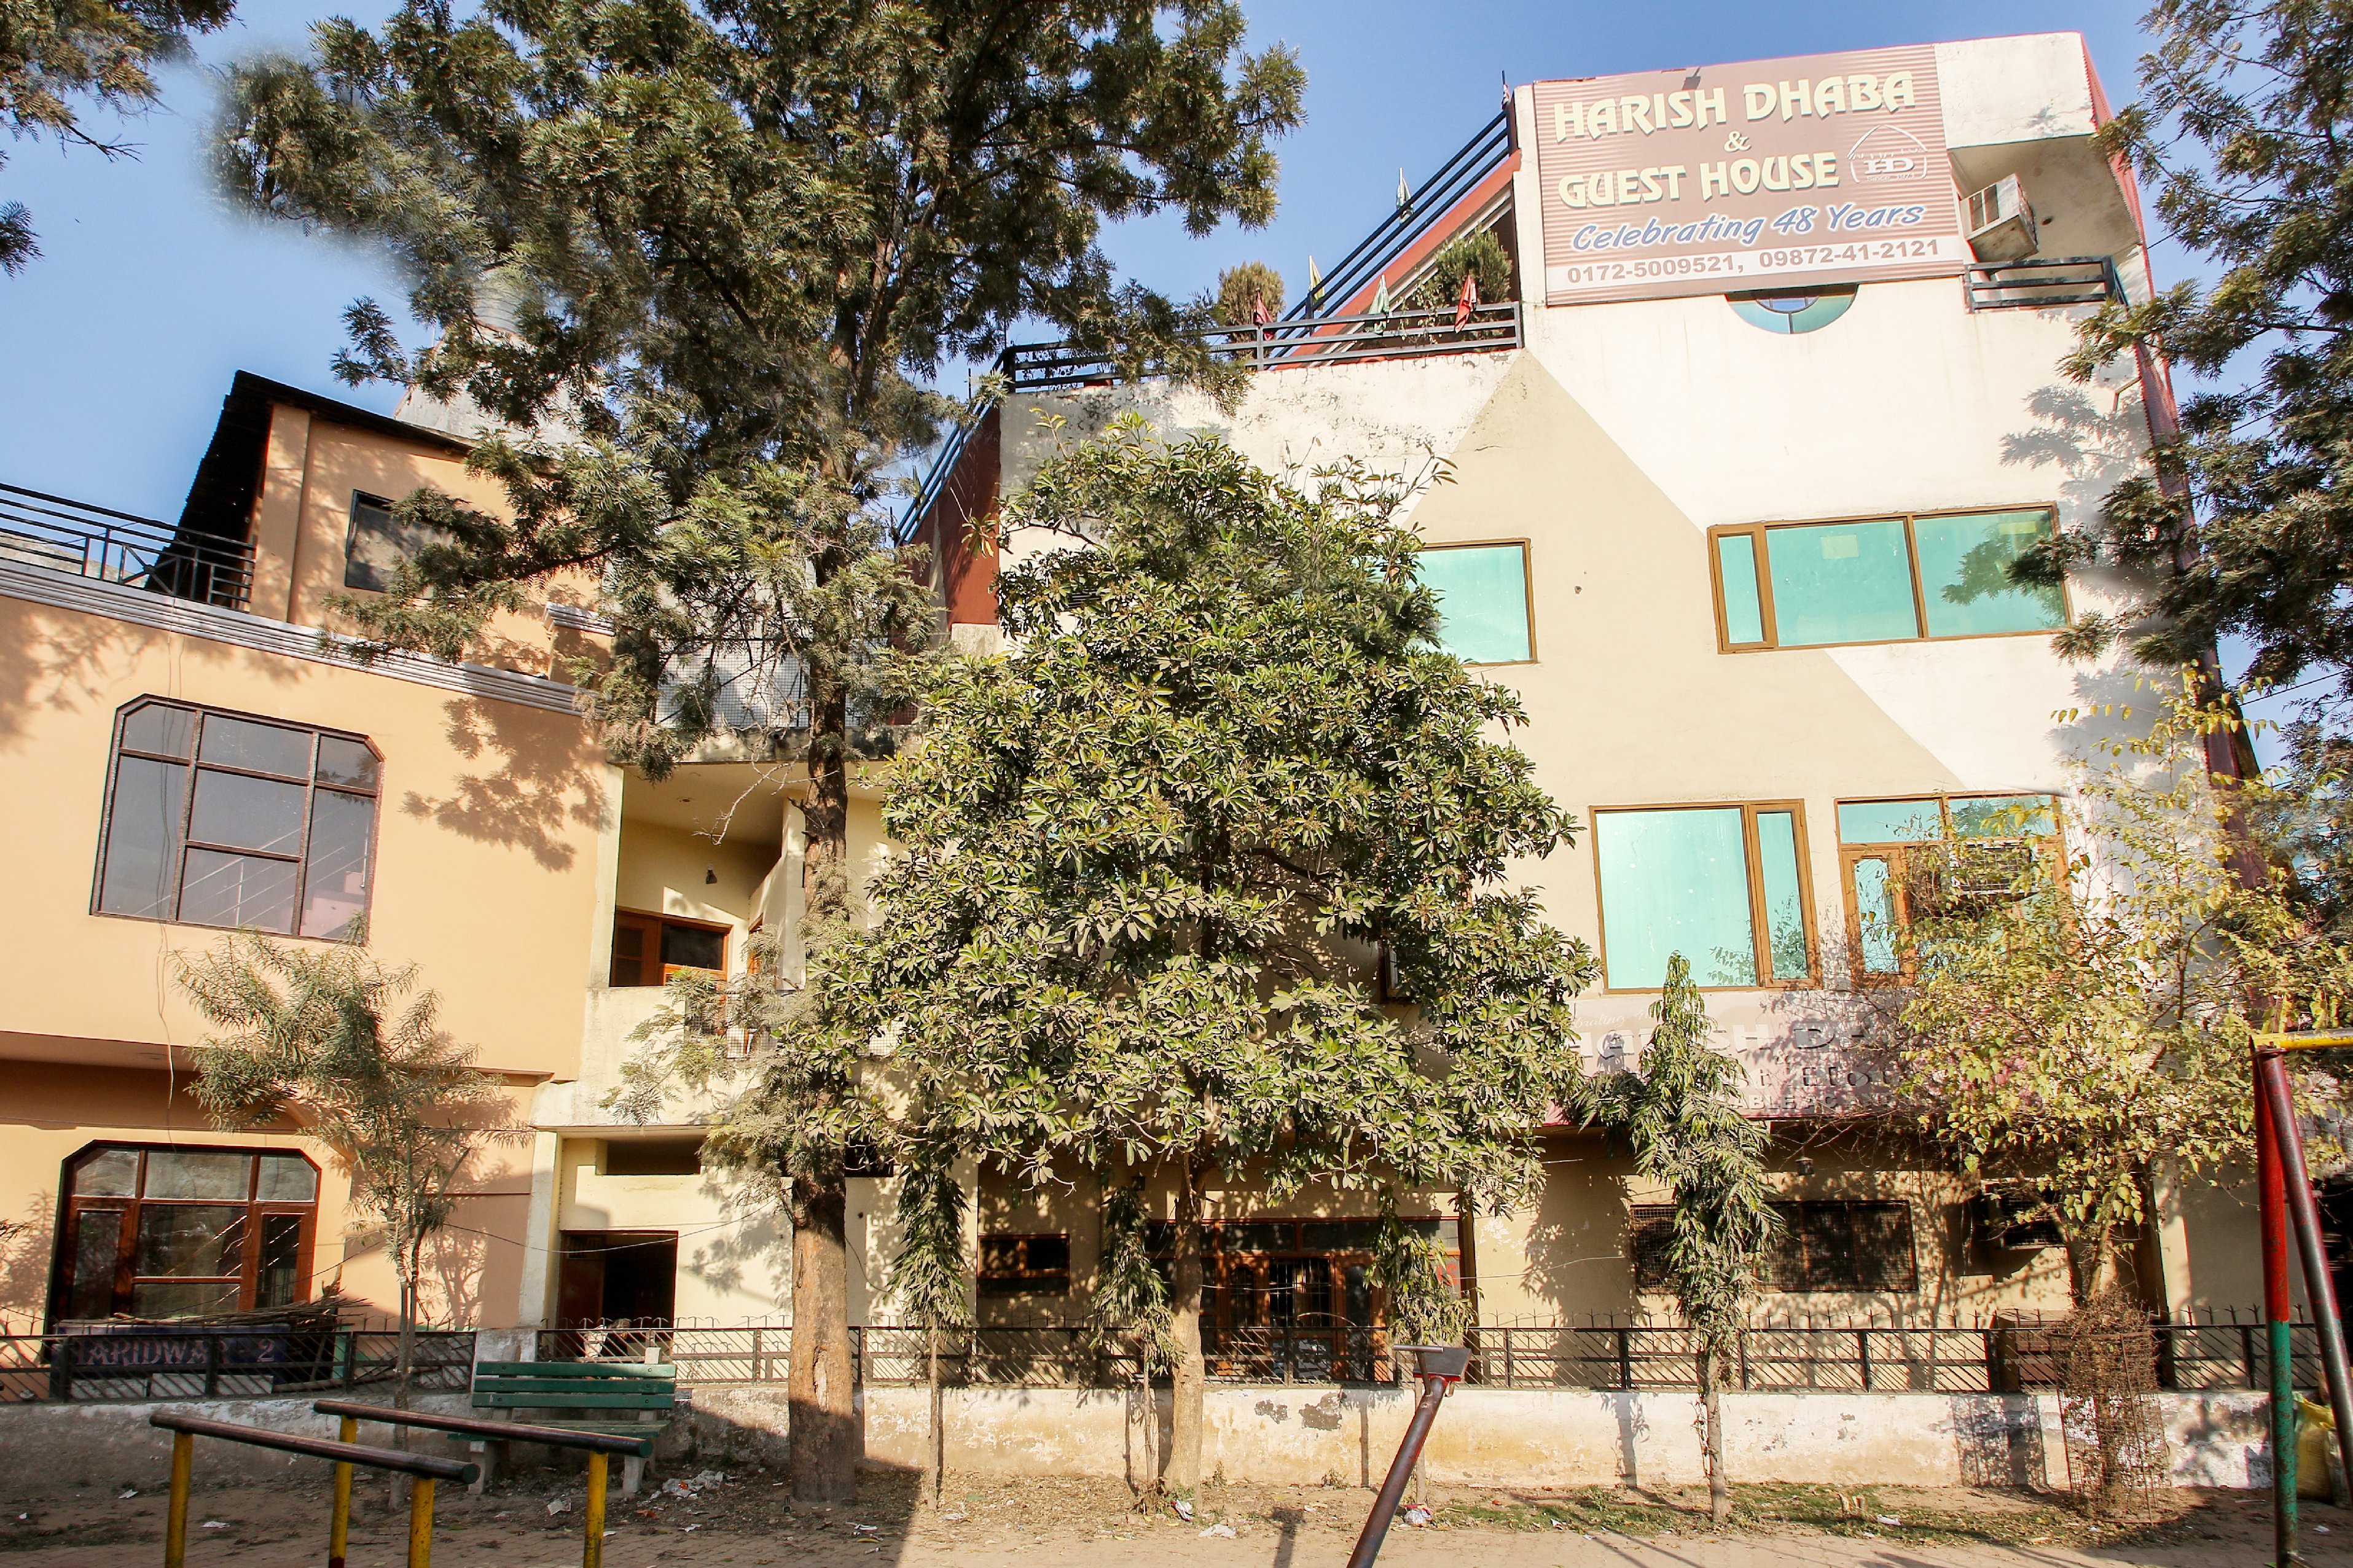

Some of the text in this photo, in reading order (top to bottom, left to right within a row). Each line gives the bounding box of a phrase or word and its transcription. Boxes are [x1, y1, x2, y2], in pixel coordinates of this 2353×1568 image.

[1554, 71, 1916, 144] HARISH DHABA
[1724, 131, 1752, 152] &
[1558, 152, 1840, 208] GUEST HOUSE
[1863, 158, 1914, 175] HD
[1573, 203, 1925, 250] Celebrating 48 Years
[1567, 240, 1938, 283] 0172-5009521, 09872-41-2121
[257, 1338, 275, 1363] 2
